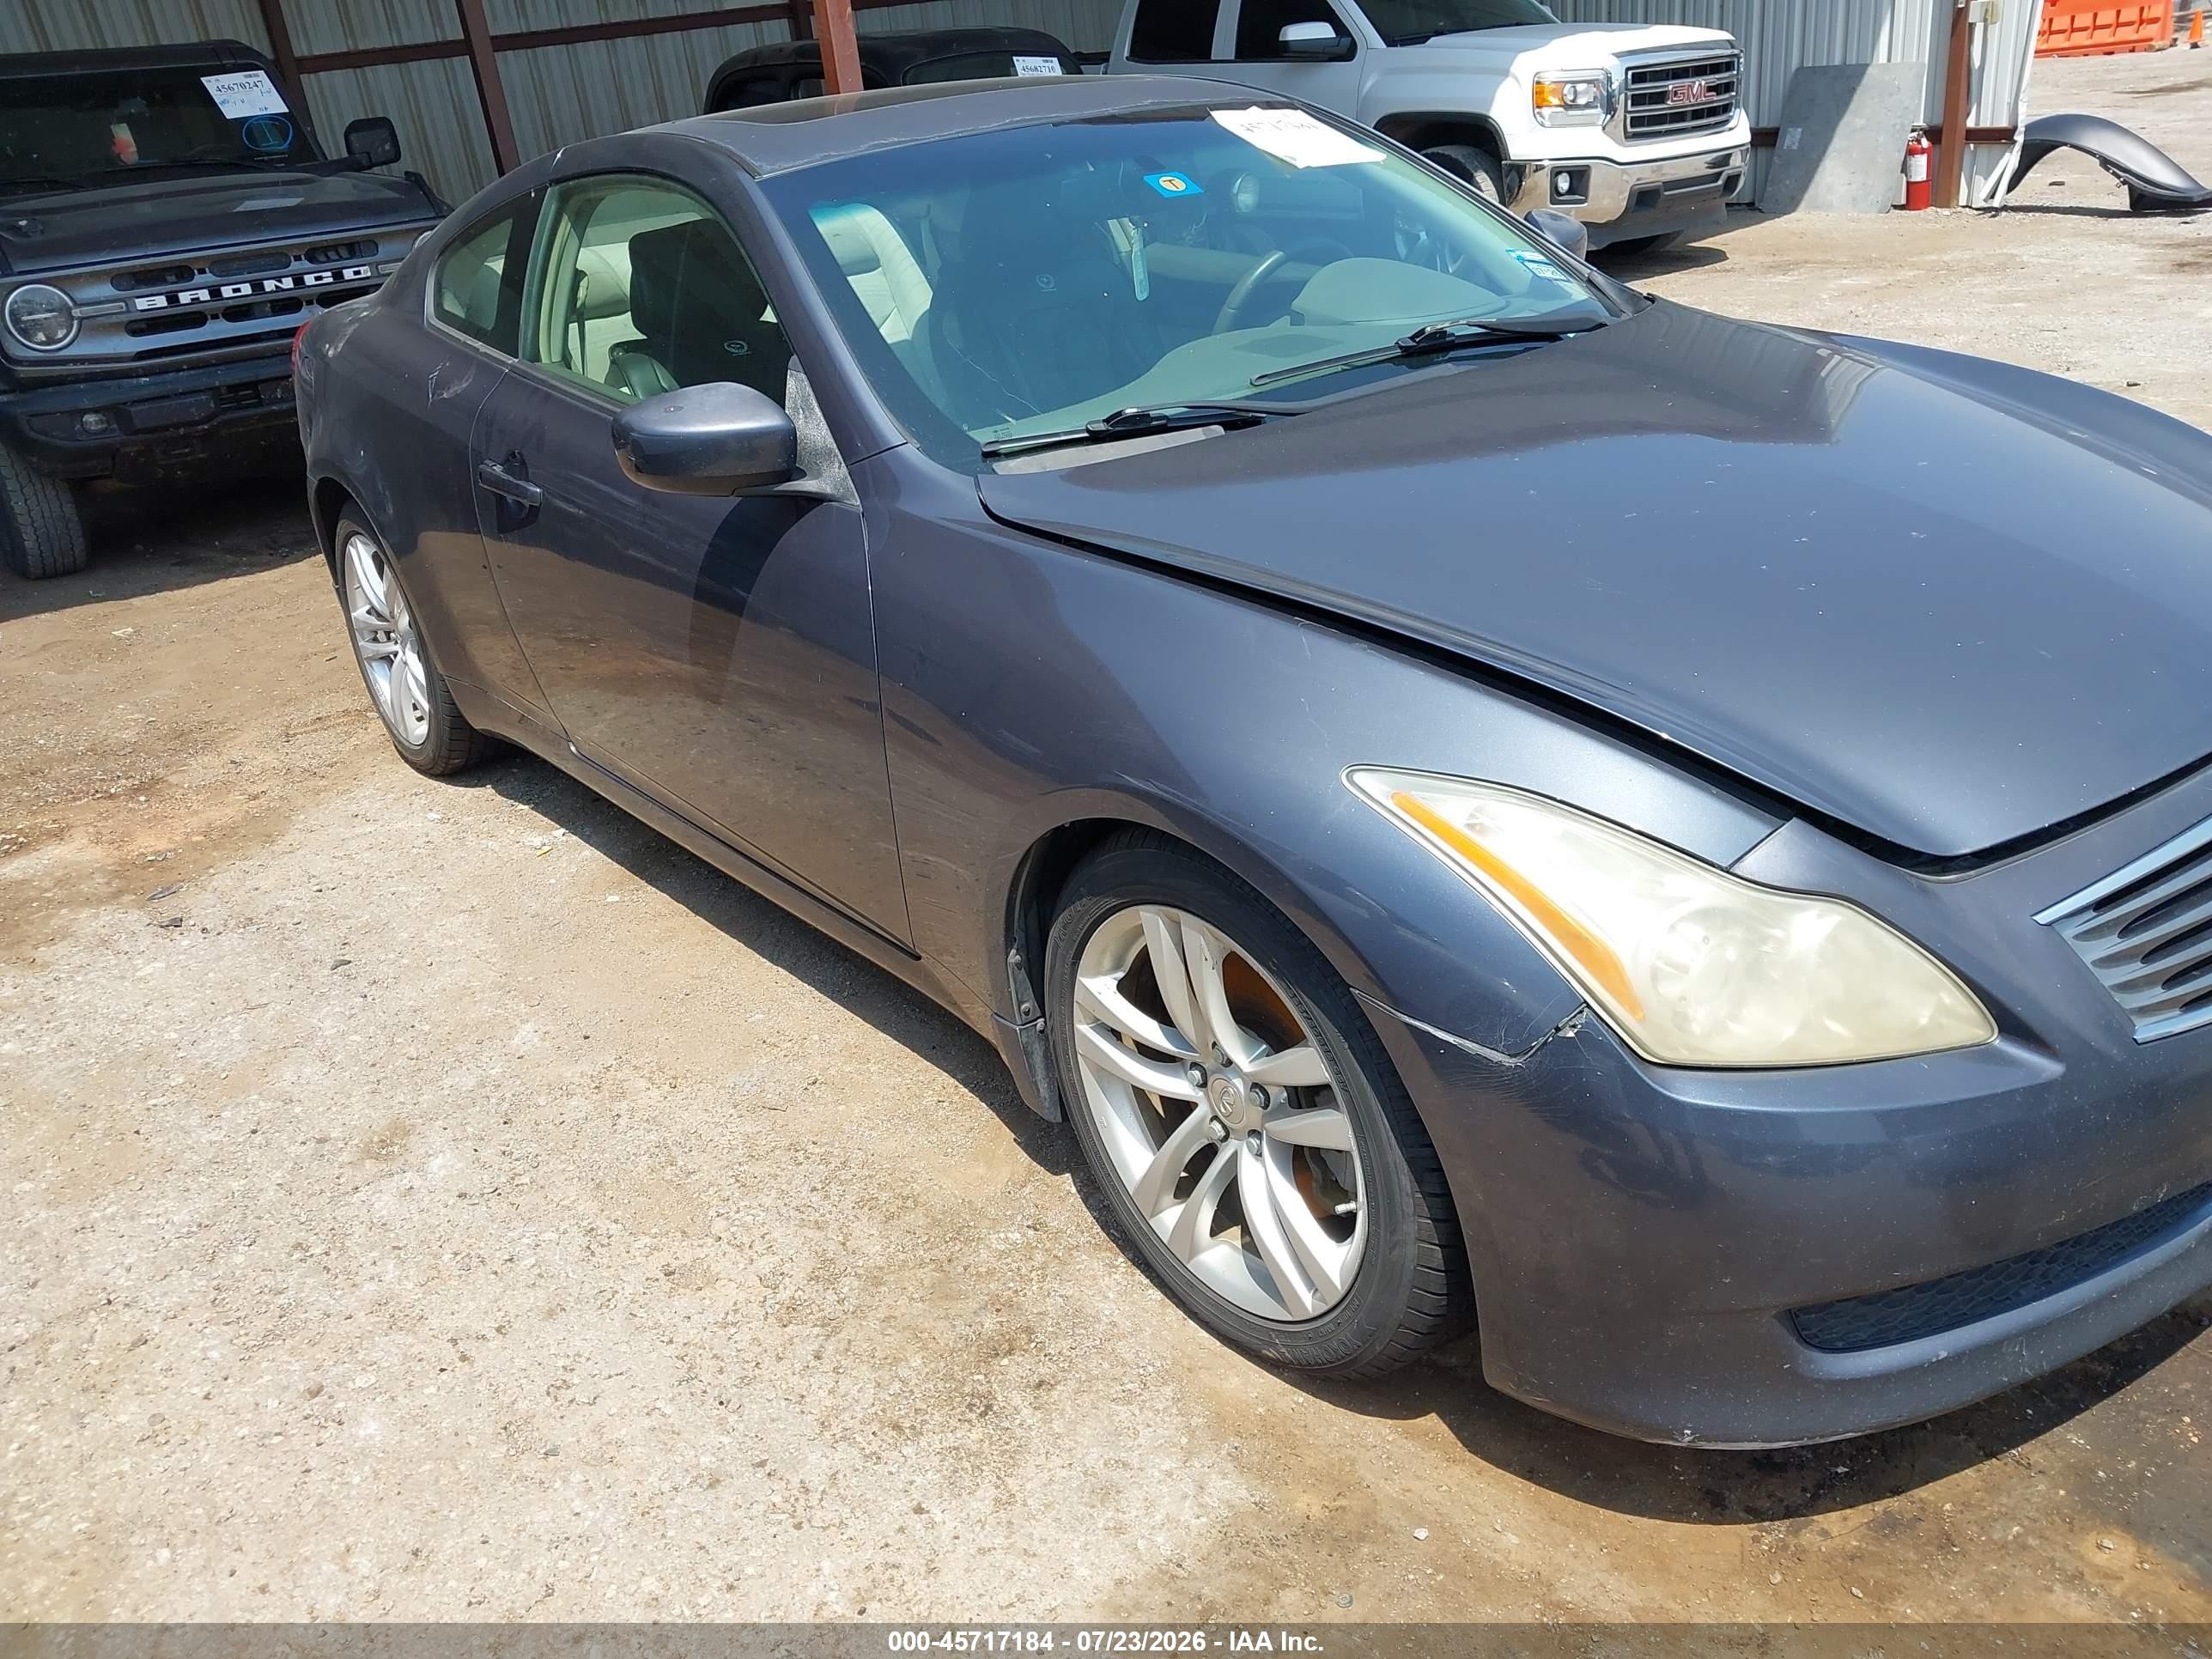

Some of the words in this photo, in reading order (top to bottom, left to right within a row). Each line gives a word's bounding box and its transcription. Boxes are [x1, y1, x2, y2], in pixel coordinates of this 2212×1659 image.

[216, 80, 264, 94] 45670247
[1668, 79, 1717, 104] GMC
[134, 265, 372, 311] BRONCO
